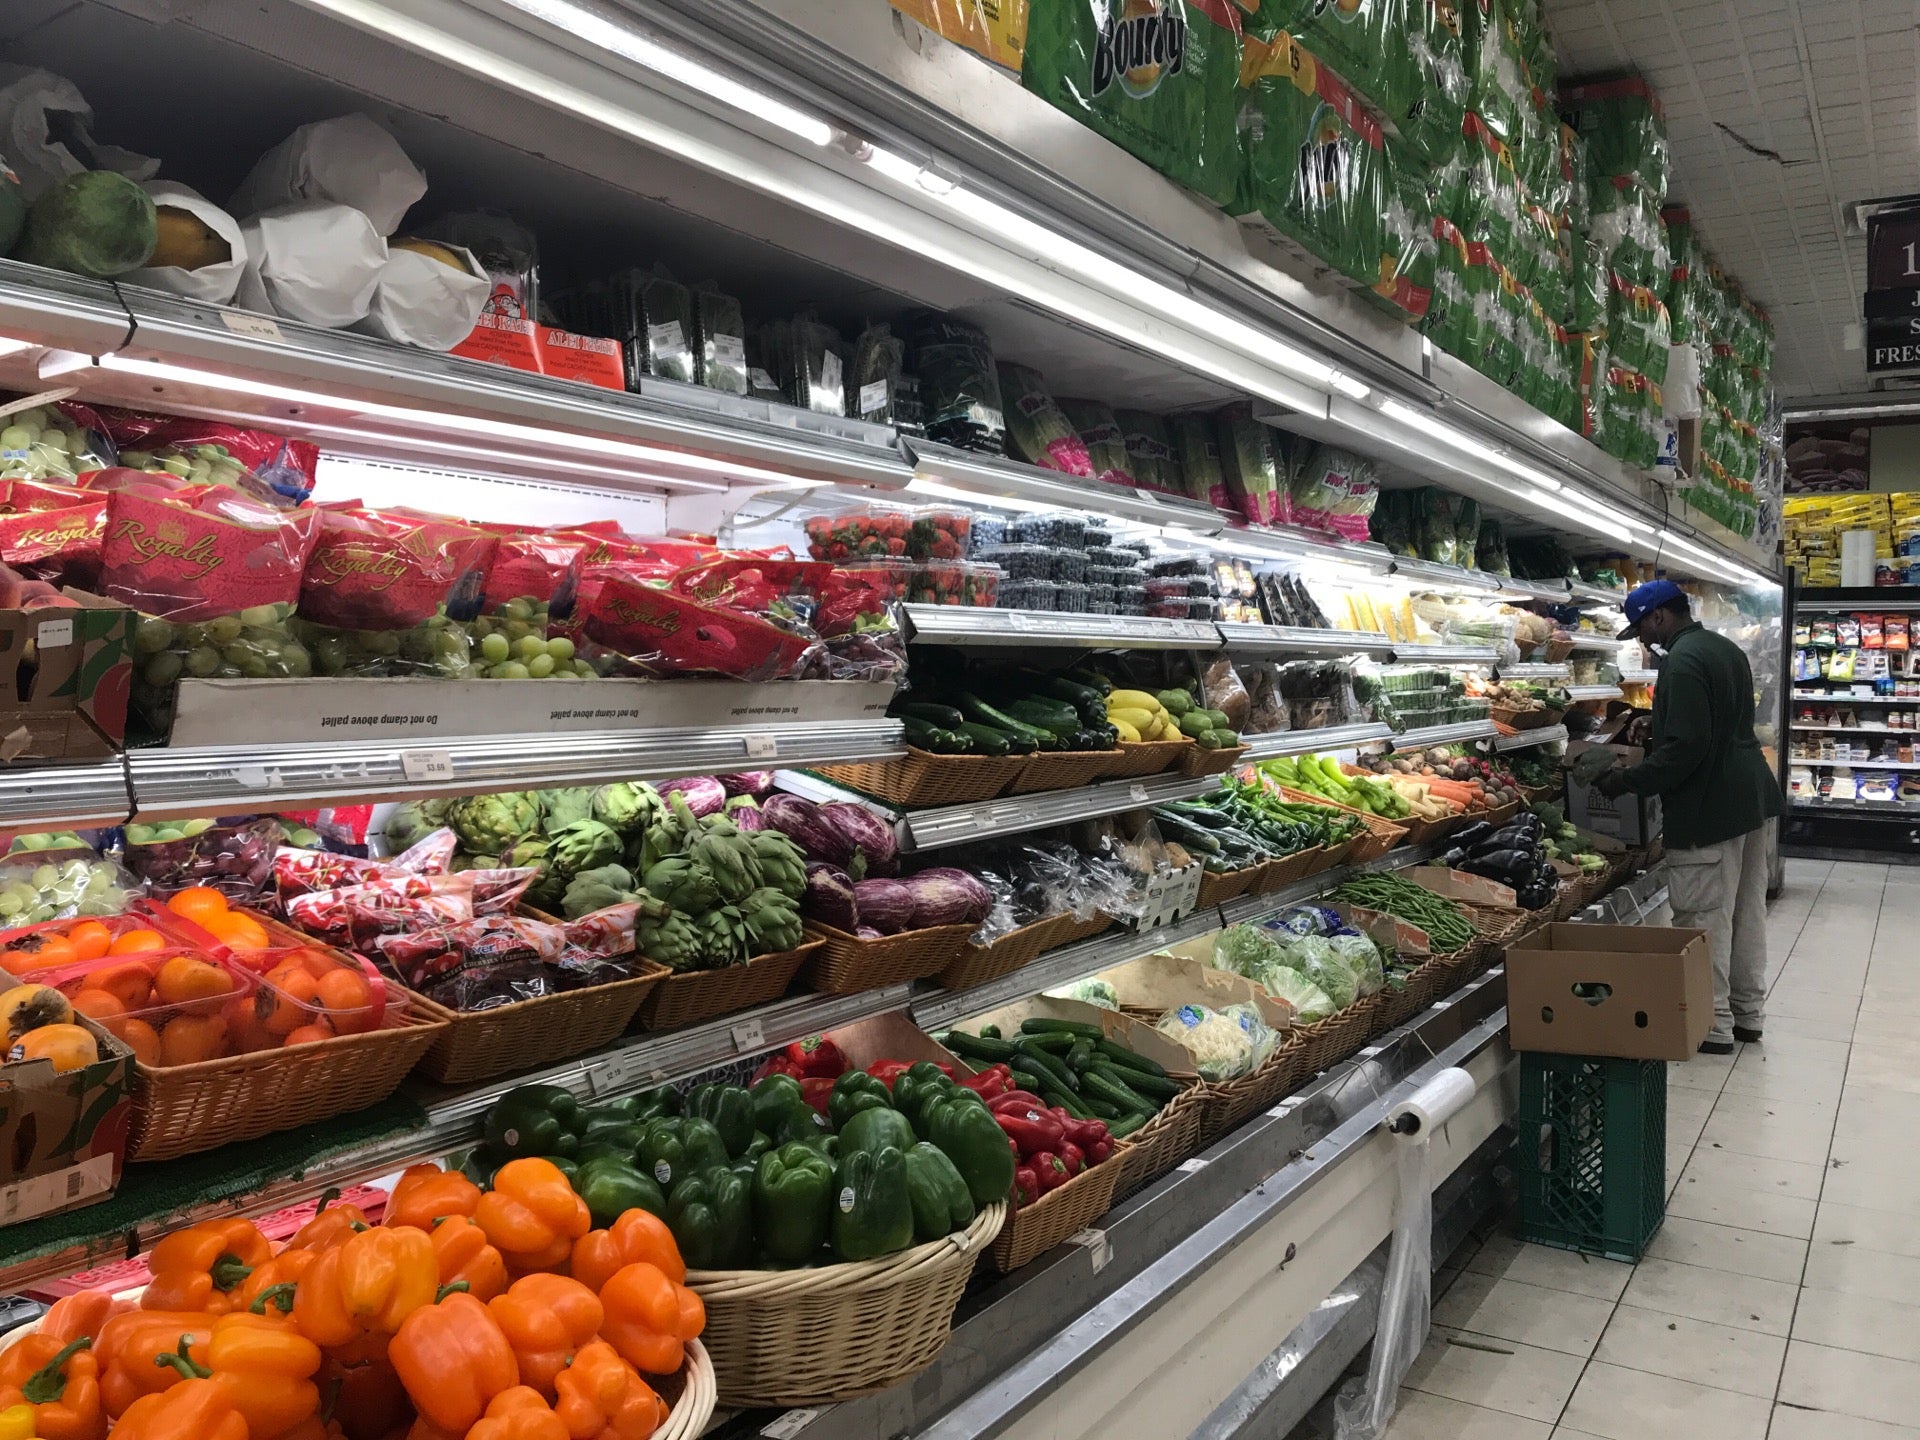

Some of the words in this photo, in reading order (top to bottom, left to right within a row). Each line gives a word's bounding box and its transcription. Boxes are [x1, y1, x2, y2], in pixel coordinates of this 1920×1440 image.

[1092, 6, 1185, 98] Bounty
[1290, 45, 1299, 72] 15
[15, 527, 104, 558] Royal
[112, 518, 224, 580] Royalty
[309, 549, 408, 591] Royalty
[605, 598, 682, 638] Royalty
[550, 710, 572, 720] pallet
[573, 710, 594, 719] above
[595, 709, 616, 718] clamp
[617, 709, 628, 718] not
[629, 709, 638, 718] Do
[321, 714, 349, 727] pallet
[351, 716, 378, 726] above
[381, 714, 408, 725] clamp
[410, 715, 424, 725] not
[427, 715, 438, 725] Do
